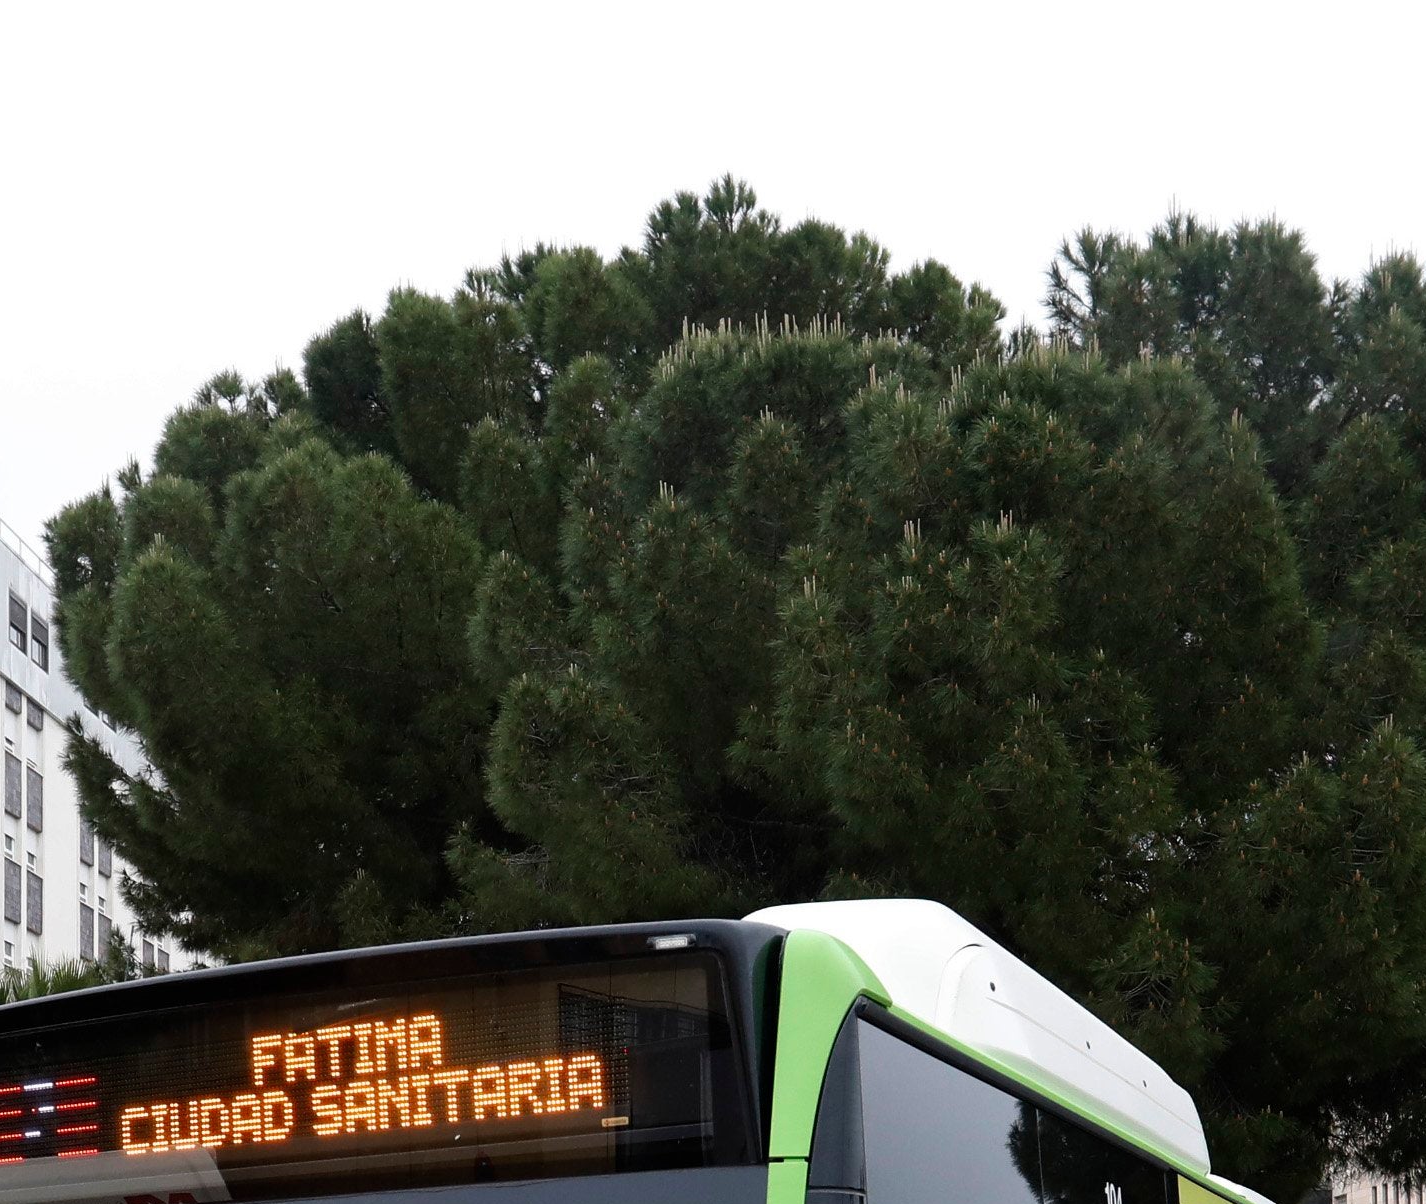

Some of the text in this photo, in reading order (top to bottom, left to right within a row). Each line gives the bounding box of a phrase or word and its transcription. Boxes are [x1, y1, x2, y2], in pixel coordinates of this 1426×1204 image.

[252, 1014, 442, 1086] FATIMA
[121, 1091, 295, 1156] CIUDAD
[310, 1055, 603, 1137] SANITARIA
